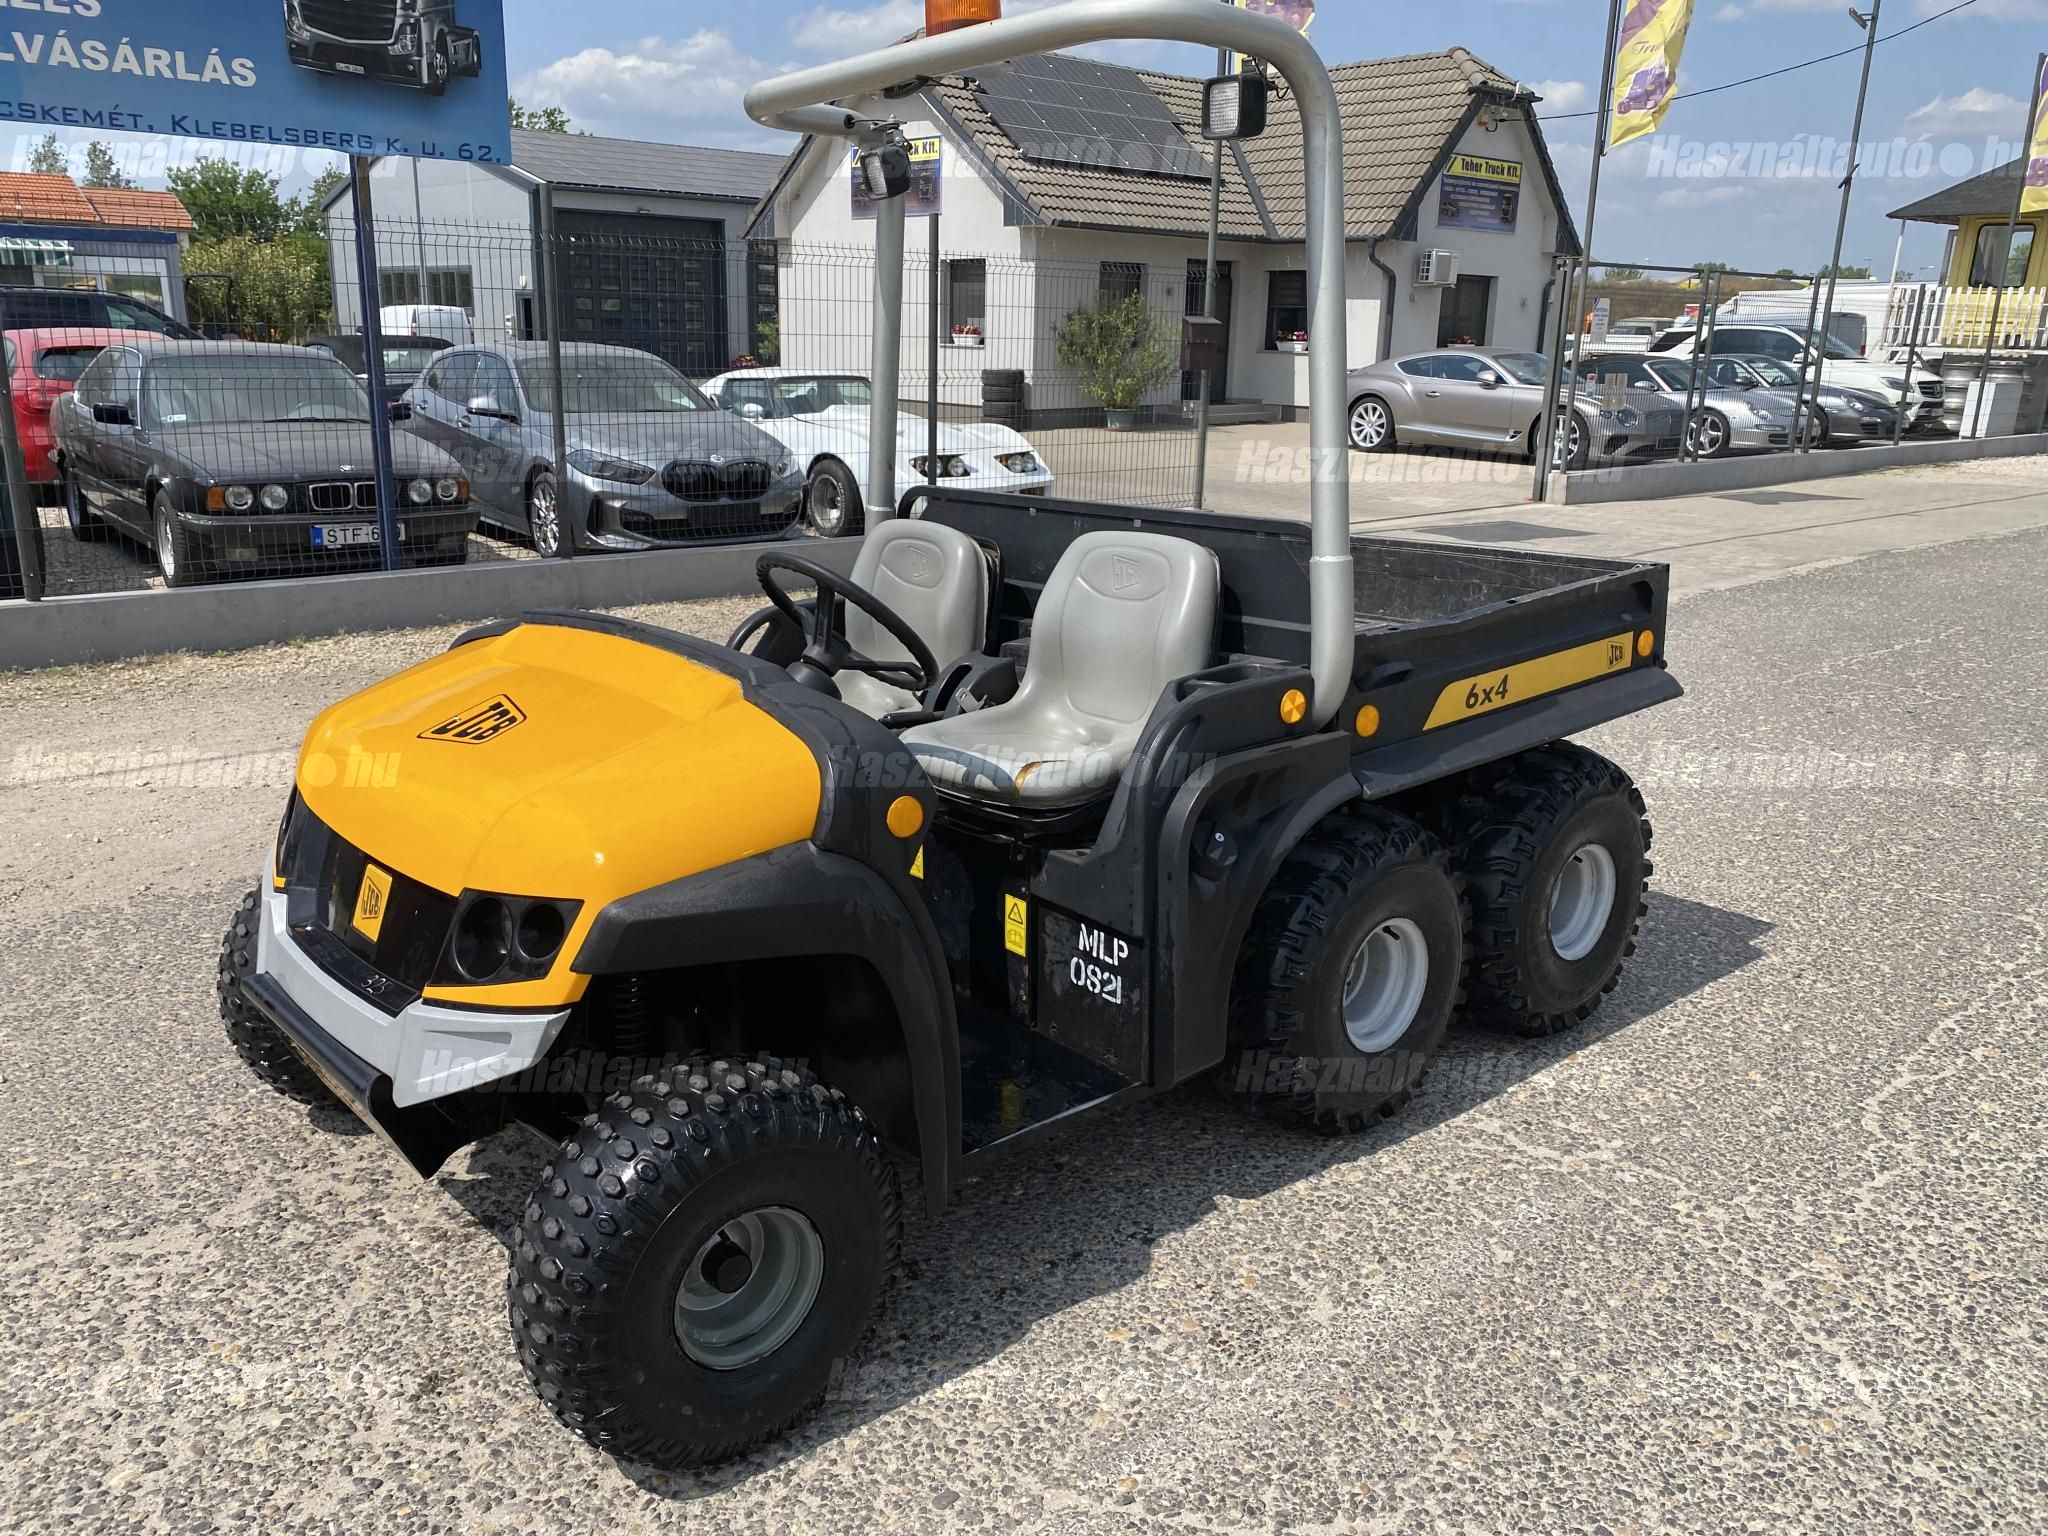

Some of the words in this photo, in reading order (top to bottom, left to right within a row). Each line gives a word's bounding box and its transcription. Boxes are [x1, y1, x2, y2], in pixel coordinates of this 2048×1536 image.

[458, 142, 502, 163] 62.
[1607, 644, 1624, 666] JCB
[1465, 674, 1509, 709] 6x4
[428, 700, 519, 742] JCB
[362, 883, 381, 916] JCB
[1078, 922, 1129, 967] MLP
